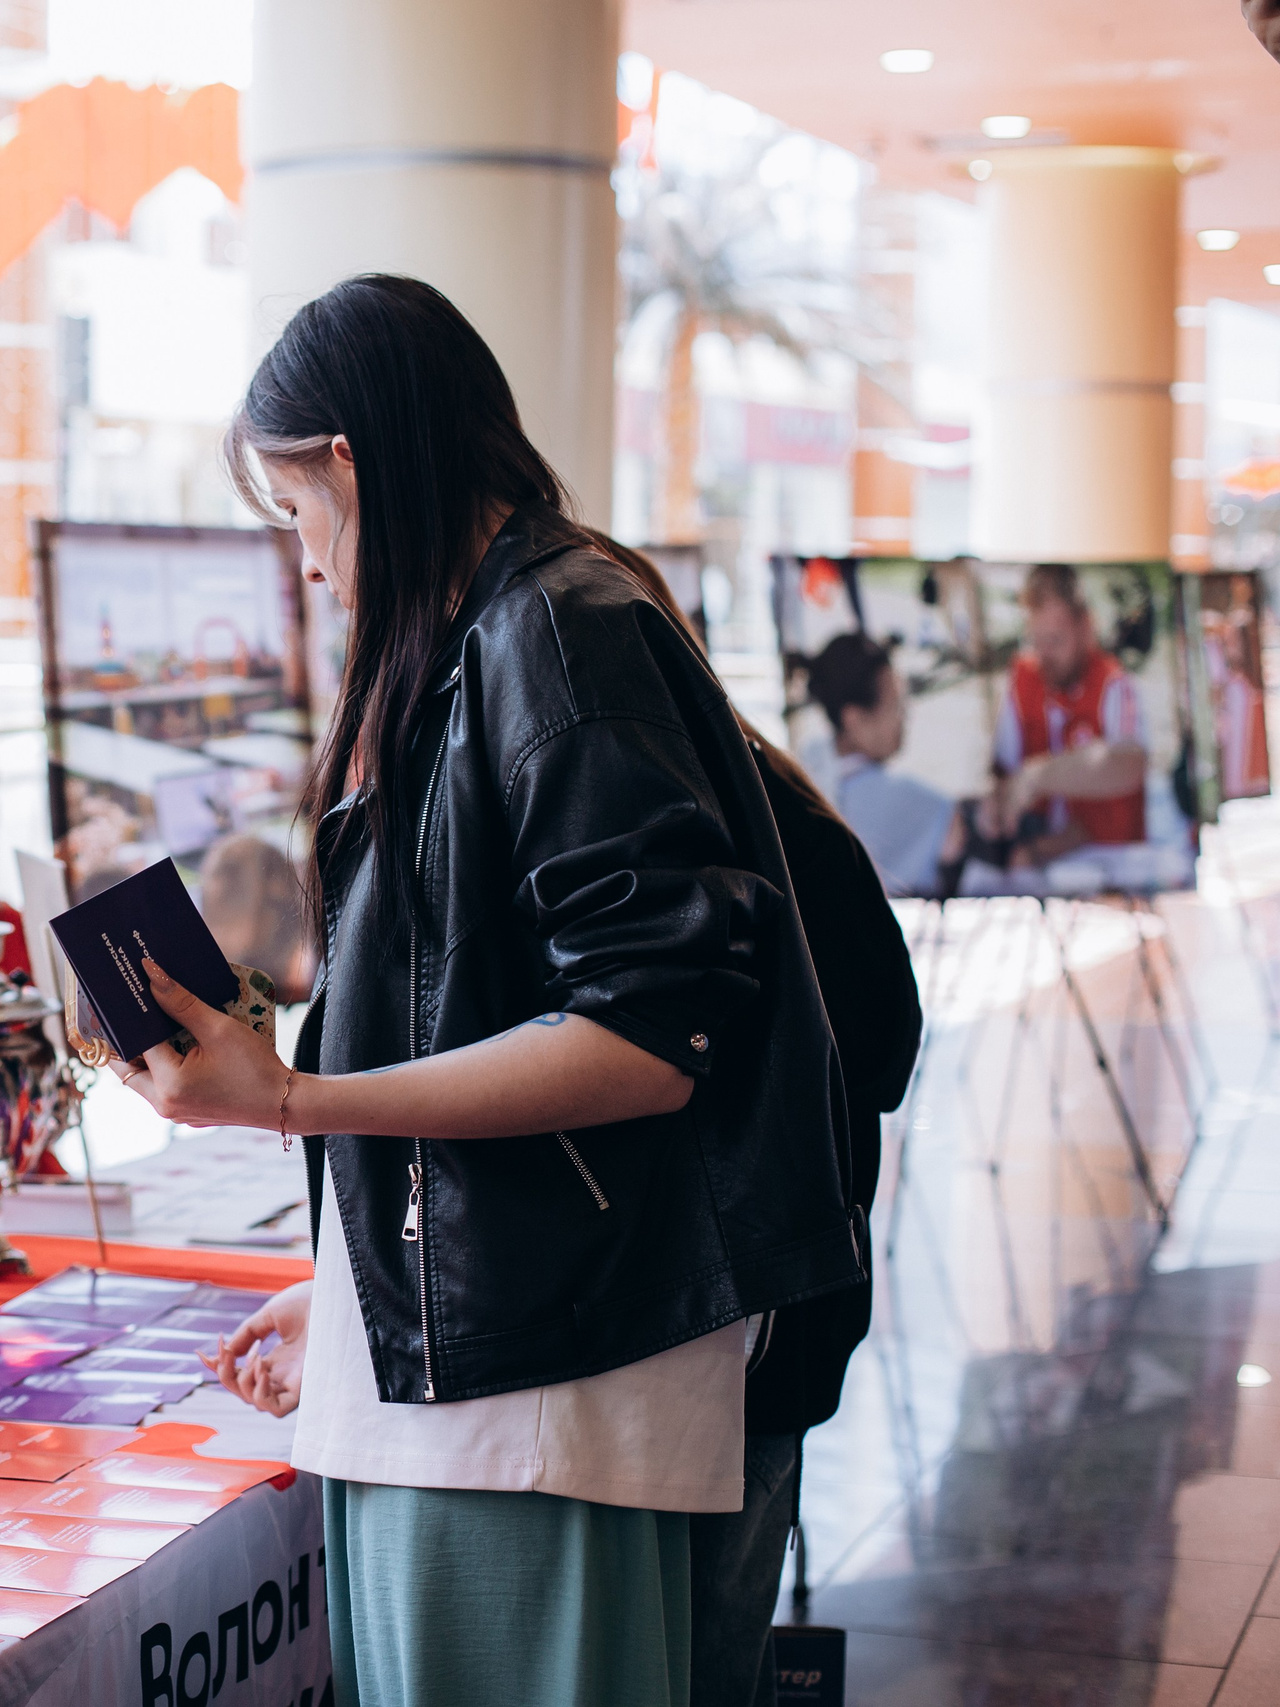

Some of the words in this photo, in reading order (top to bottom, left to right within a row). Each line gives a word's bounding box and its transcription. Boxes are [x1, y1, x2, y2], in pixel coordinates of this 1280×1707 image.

[132, 929, 155, 963] ро.рф
[101, 932, 148, 1013] ВОЛОНТЕРСКАЯ
[118, 945, 144, 992] КНИЖКА
[777, 1669, 822, 1688] тер
